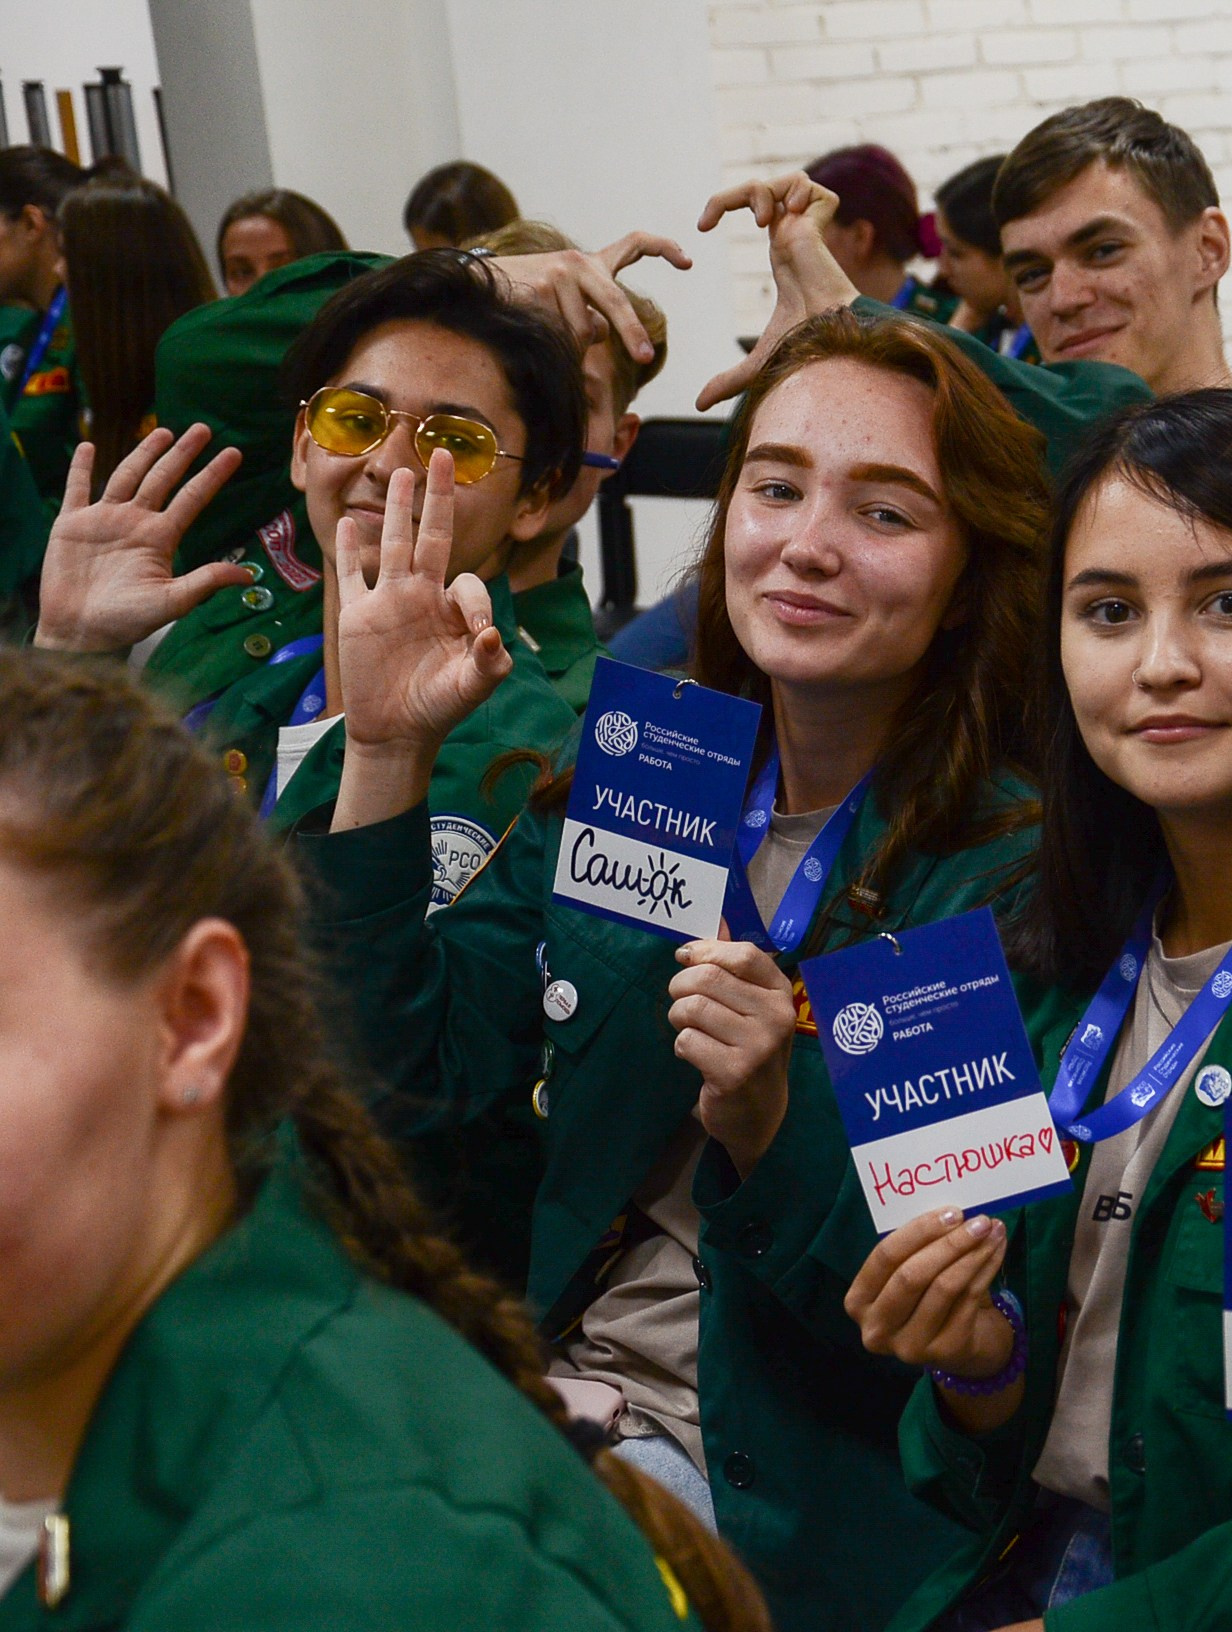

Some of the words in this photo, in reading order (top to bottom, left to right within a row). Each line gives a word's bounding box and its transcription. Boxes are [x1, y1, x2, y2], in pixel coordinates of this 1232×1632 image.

[643, 721, 699, 746] Российские
[637, 753, 674, 772] РАБОТА
[642, 731, 706, 756] студенческие
[706, 749, 741, 767] отряды
[592, 784, 718, 847] УЧАСТНИК
[430, 821, 491, 851] СТУДЕНЧЕСКИЕ
[448, 849, 481, 871] РСО
[881, 980, 947, 1006] Российские
[884, 986, 959, 1014] студенческие
[959, 973, 1000, 992] отряды
[892, 1021, 934, 1042] РАБОТА
[864, 1050, 1017, 1122] УЧАСТНИК
[868, 1132, 1036, 1207] Настюшка
